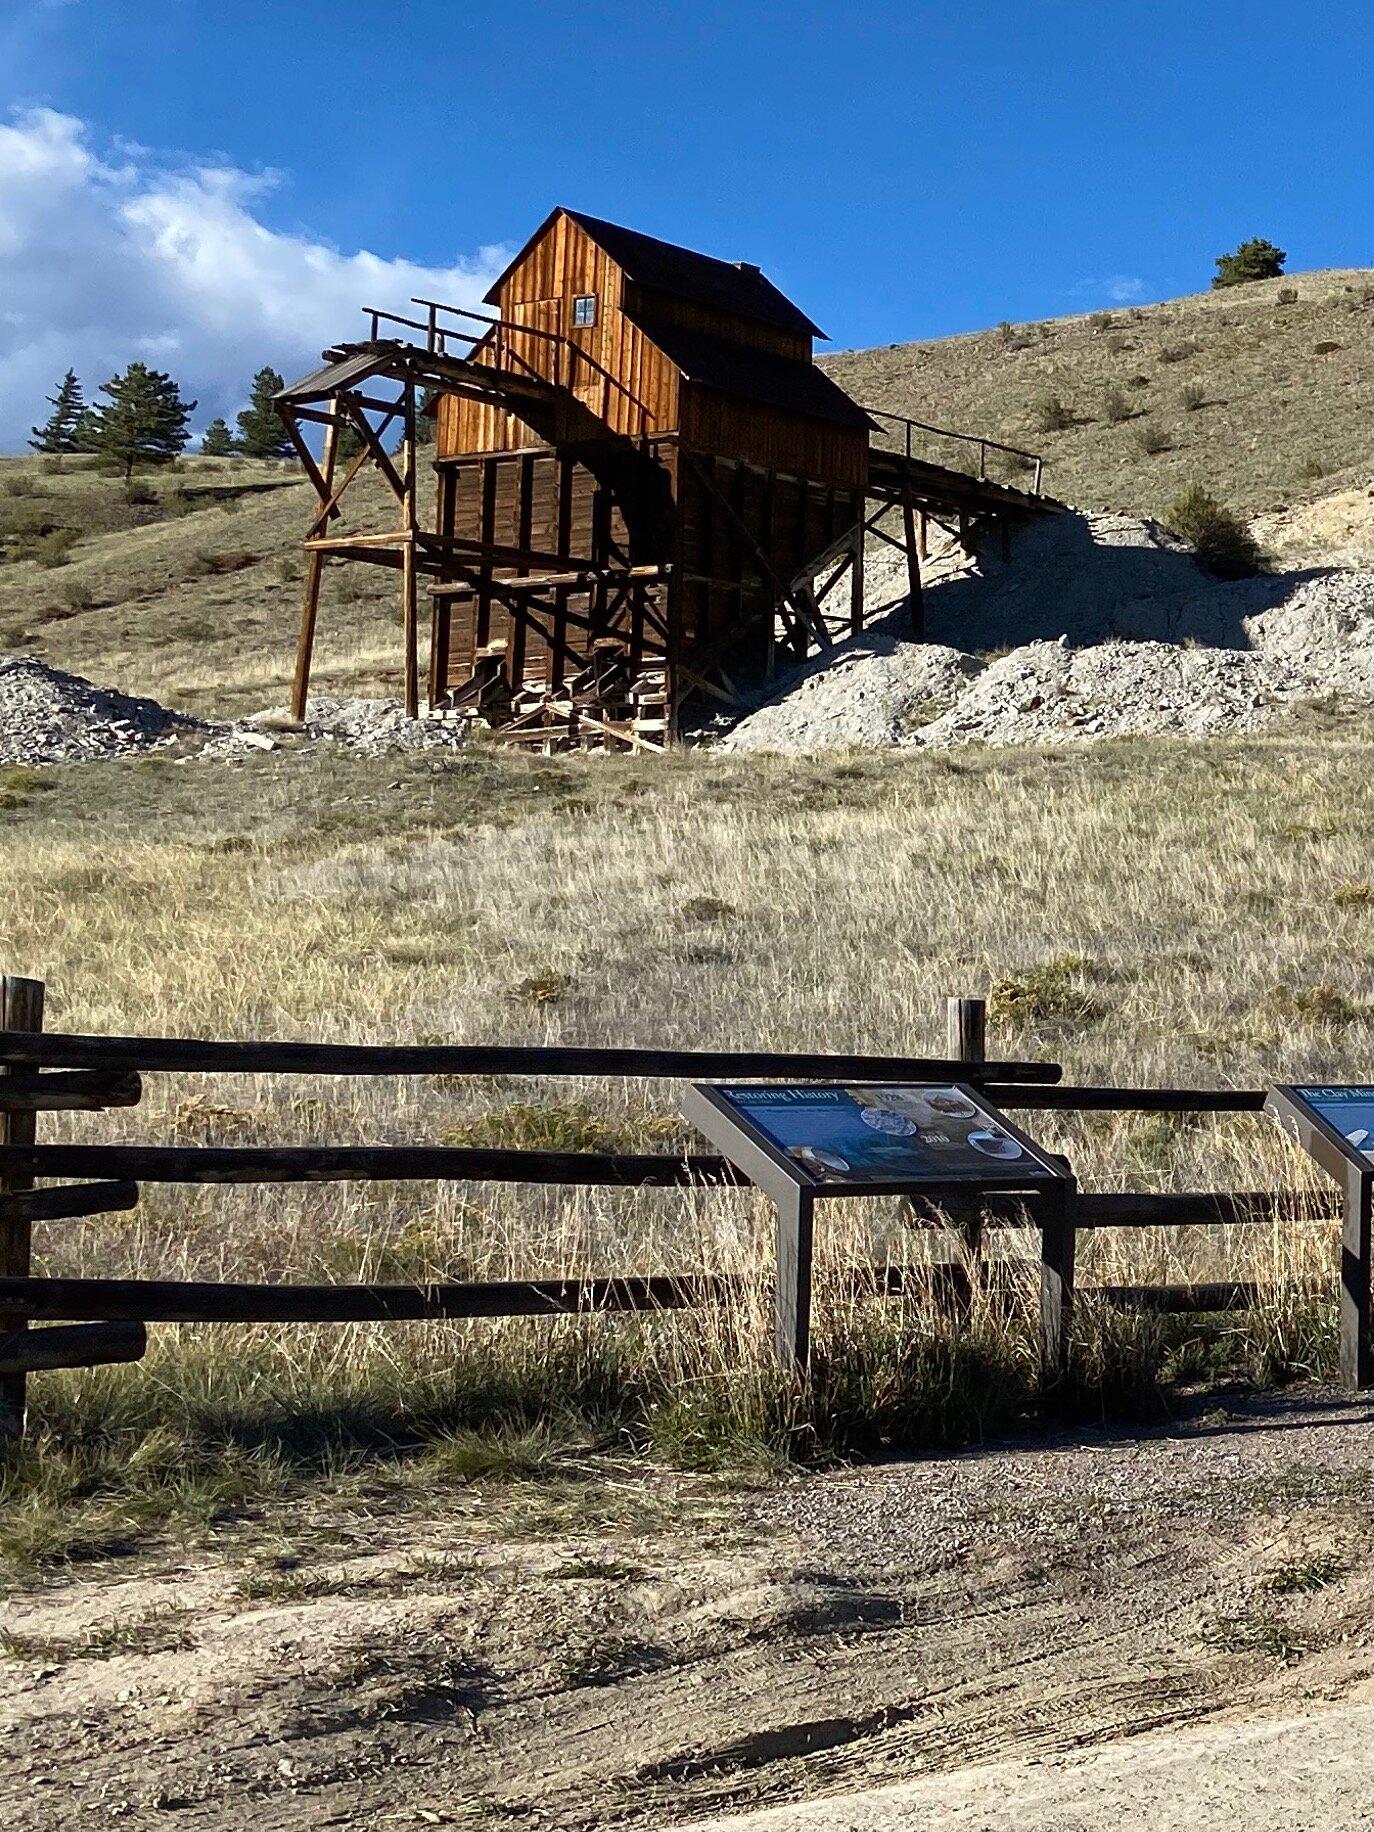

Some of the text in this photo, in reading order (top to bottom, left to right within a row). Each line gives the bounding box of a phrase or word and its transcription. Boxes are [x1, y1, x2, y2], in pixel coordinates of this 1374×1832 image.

[722, 1089, 792, 1102] Restoring
[786, 1089, 839, 1102] History
[1299, 1088, 1322, 1097] The
[1321, 1088, 1349, 1100] Clay
